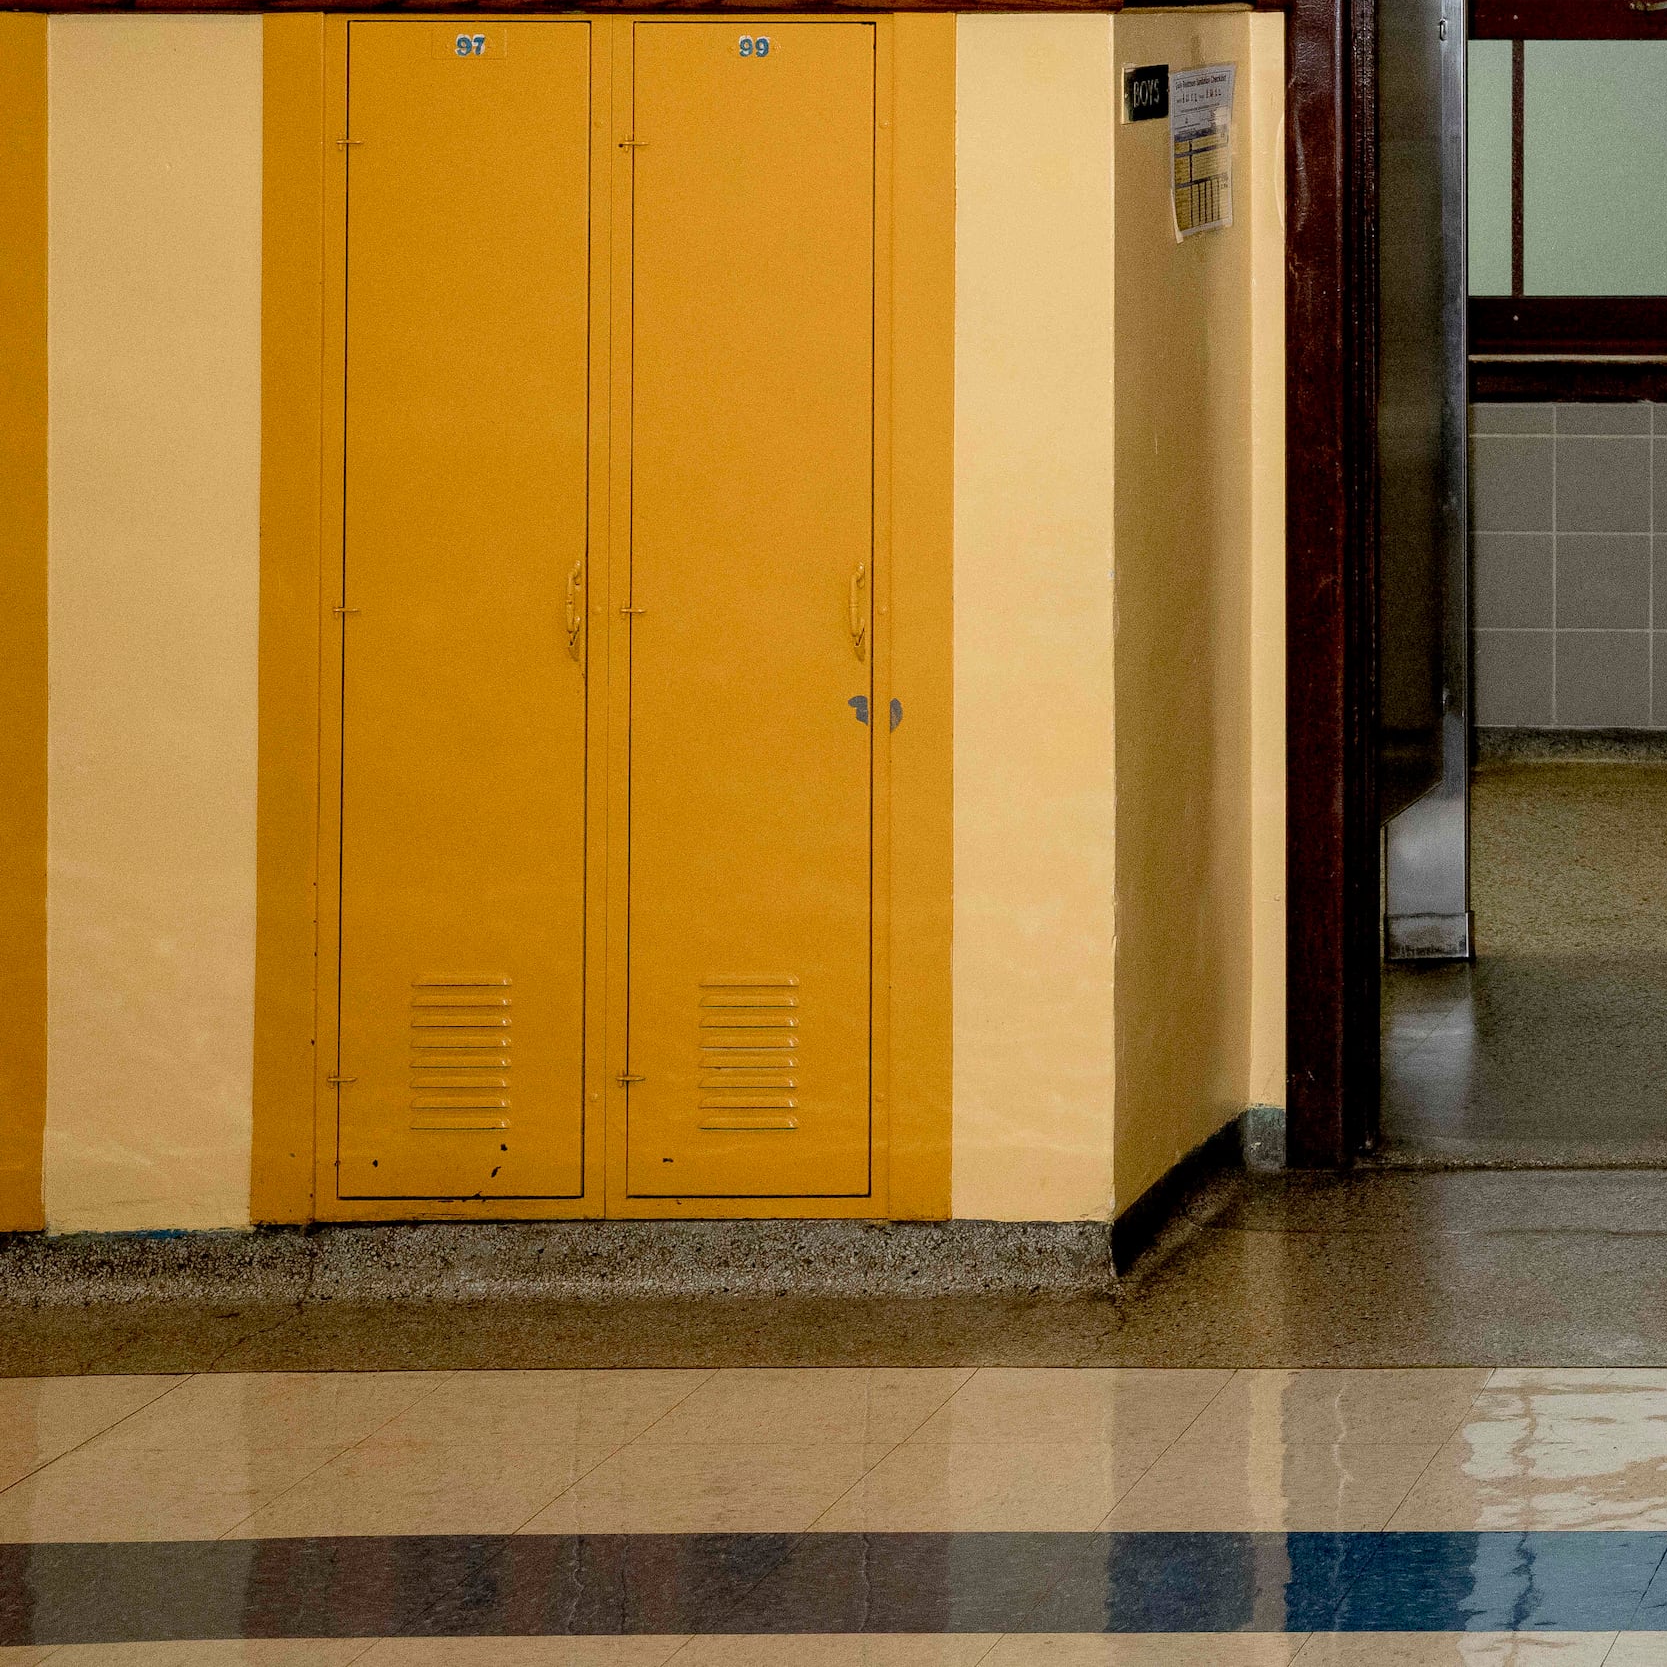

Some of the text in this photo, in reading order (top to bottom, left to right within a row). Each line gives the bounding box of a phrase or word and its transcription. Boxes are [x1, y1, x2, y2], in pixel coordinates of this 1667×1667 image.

[456, 33, 486, 57] 97
[738, 34, 770, 58] 99
[1133, 79, 1159, 108] BOYS
